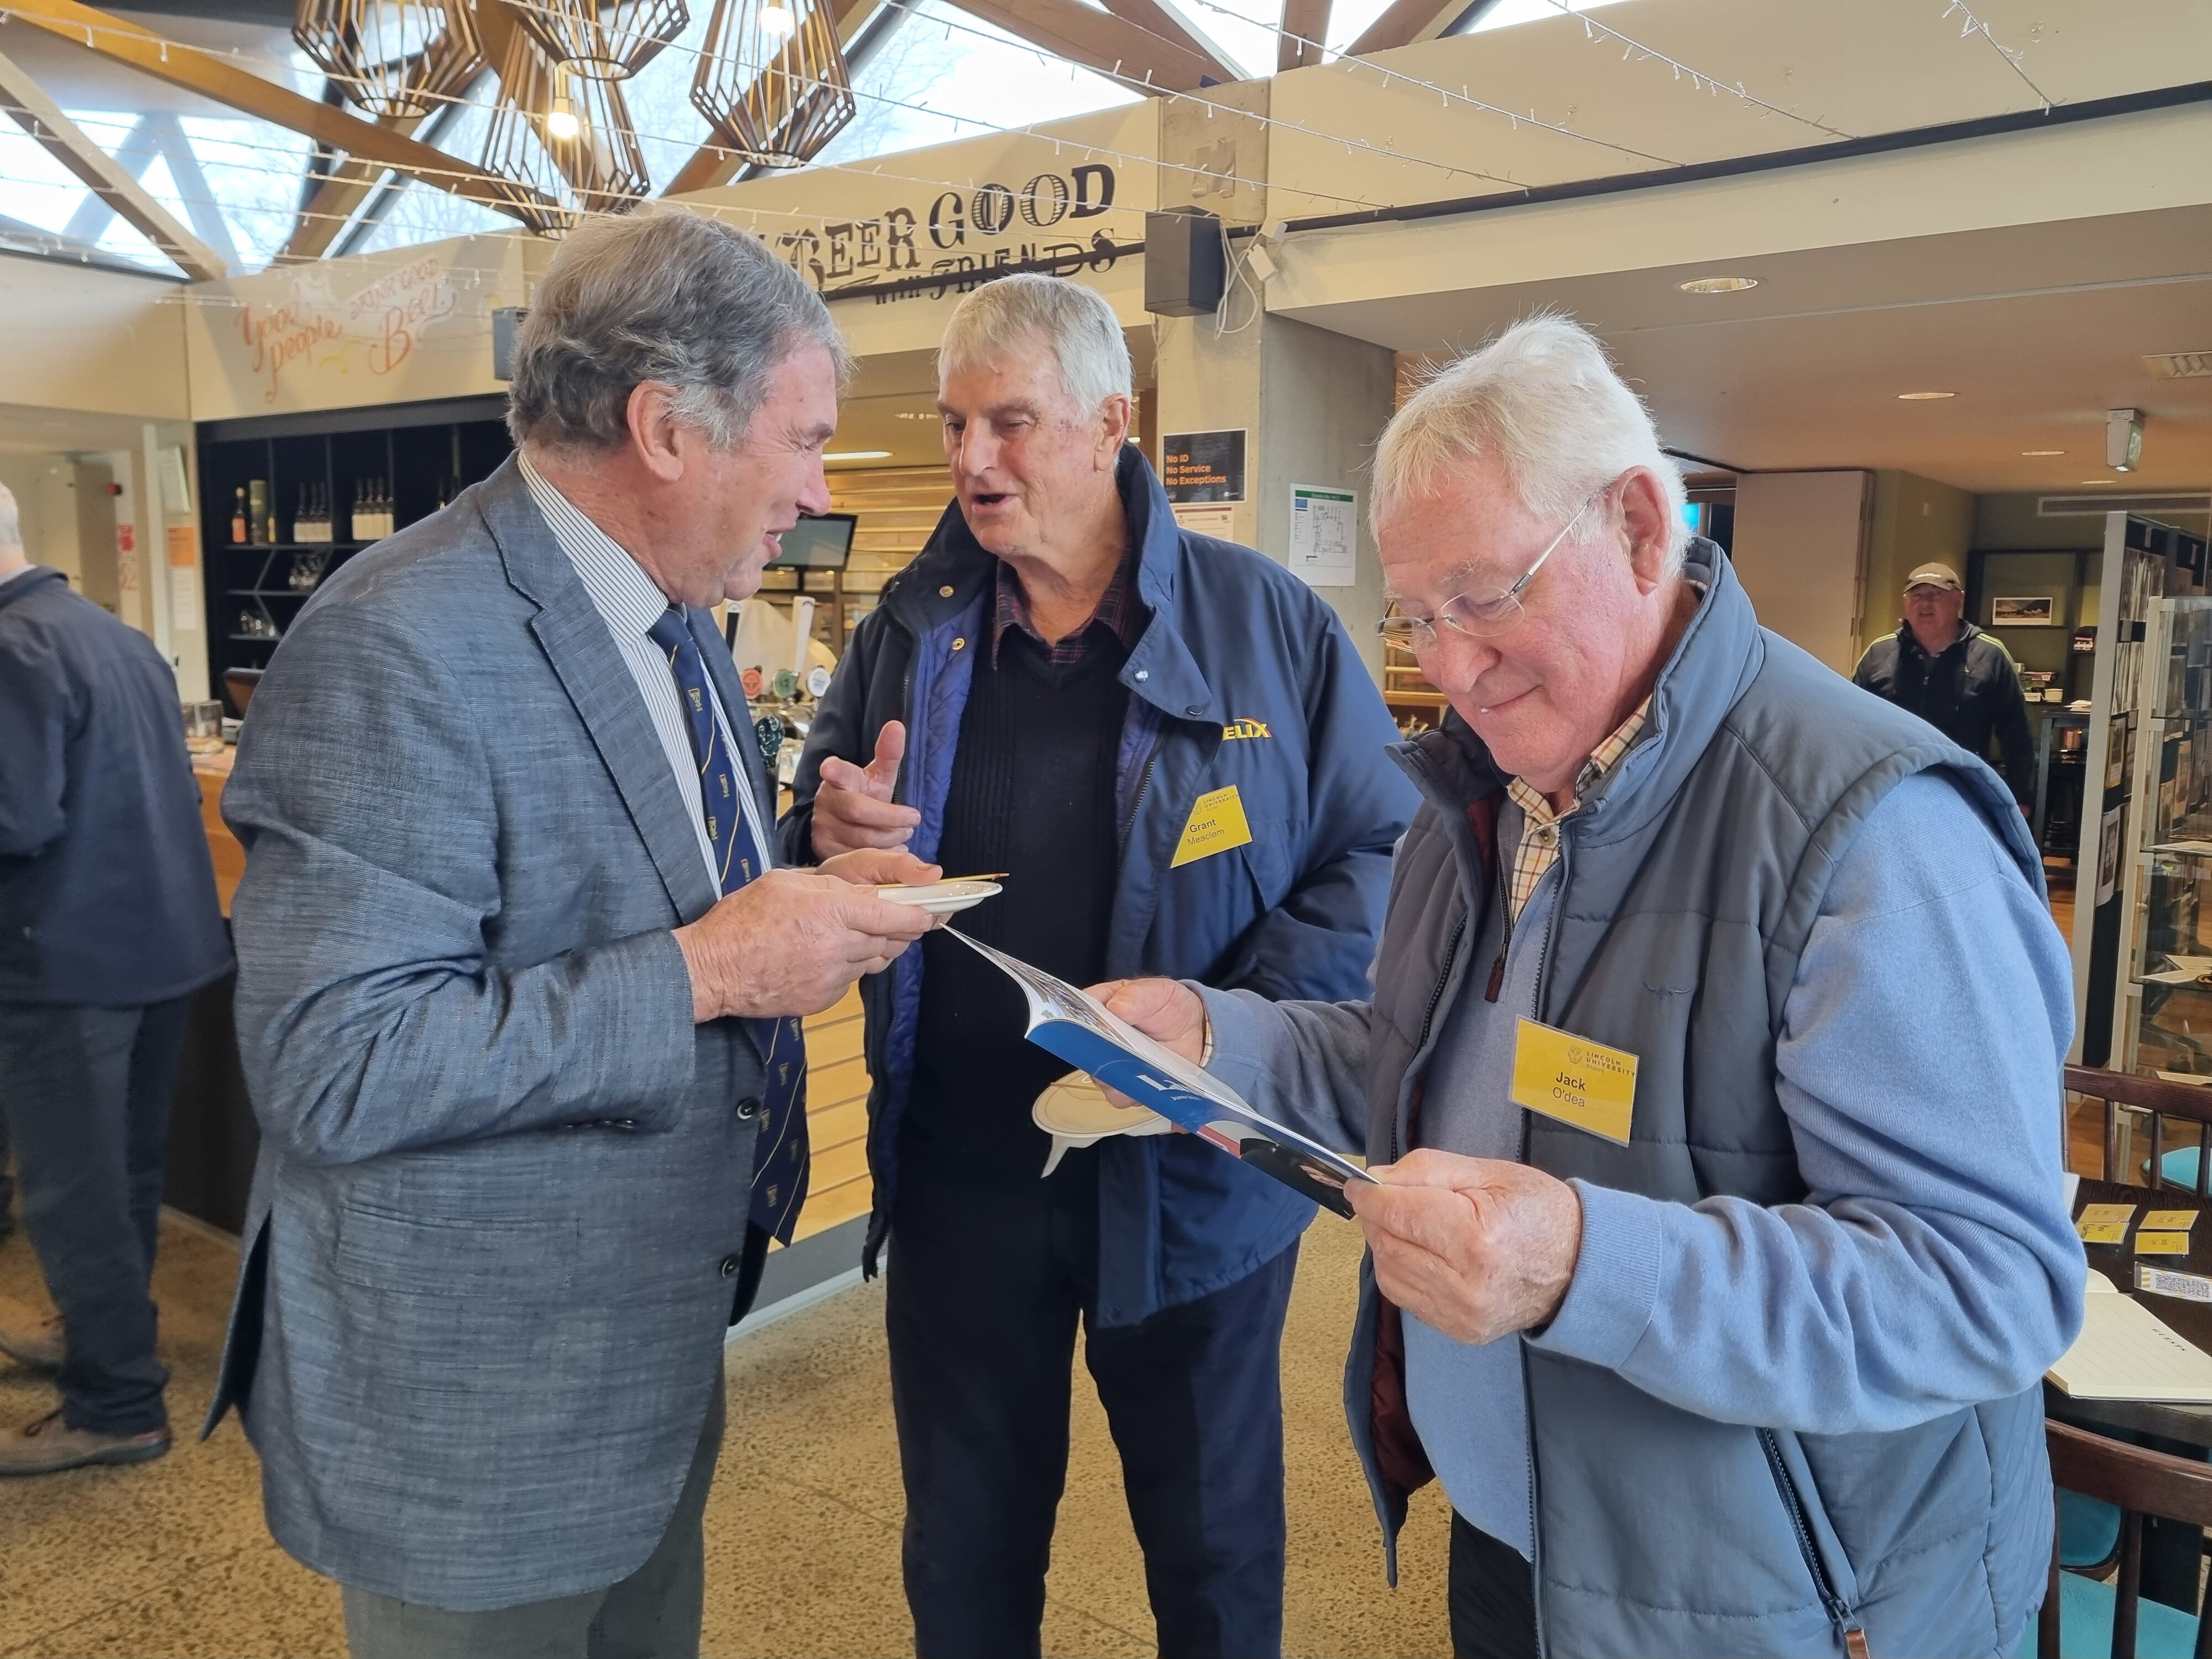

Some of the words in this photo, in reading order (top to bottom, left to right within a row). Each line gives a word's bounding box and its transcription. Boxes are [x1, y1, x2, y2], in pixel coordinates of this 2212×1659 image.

[928, 164, 1116, 249] GOOD
[1180, 454, 1189, 462] ID
[1180, 465, 1211, 473] Service
[1180, 475, 1227, 485] Exceptions
[1222, 718, 1272, 740] ELIX
[1190, 819, 1217, 833] Grant
[1586, 1058, 1636, 1078] UNIVERSITY
[1556, 1072, 1585, 1092] Jack
[1553, 1087, 1585, 1108] O'dea
[2151, 1328, 2188, 1352] GUESTS
